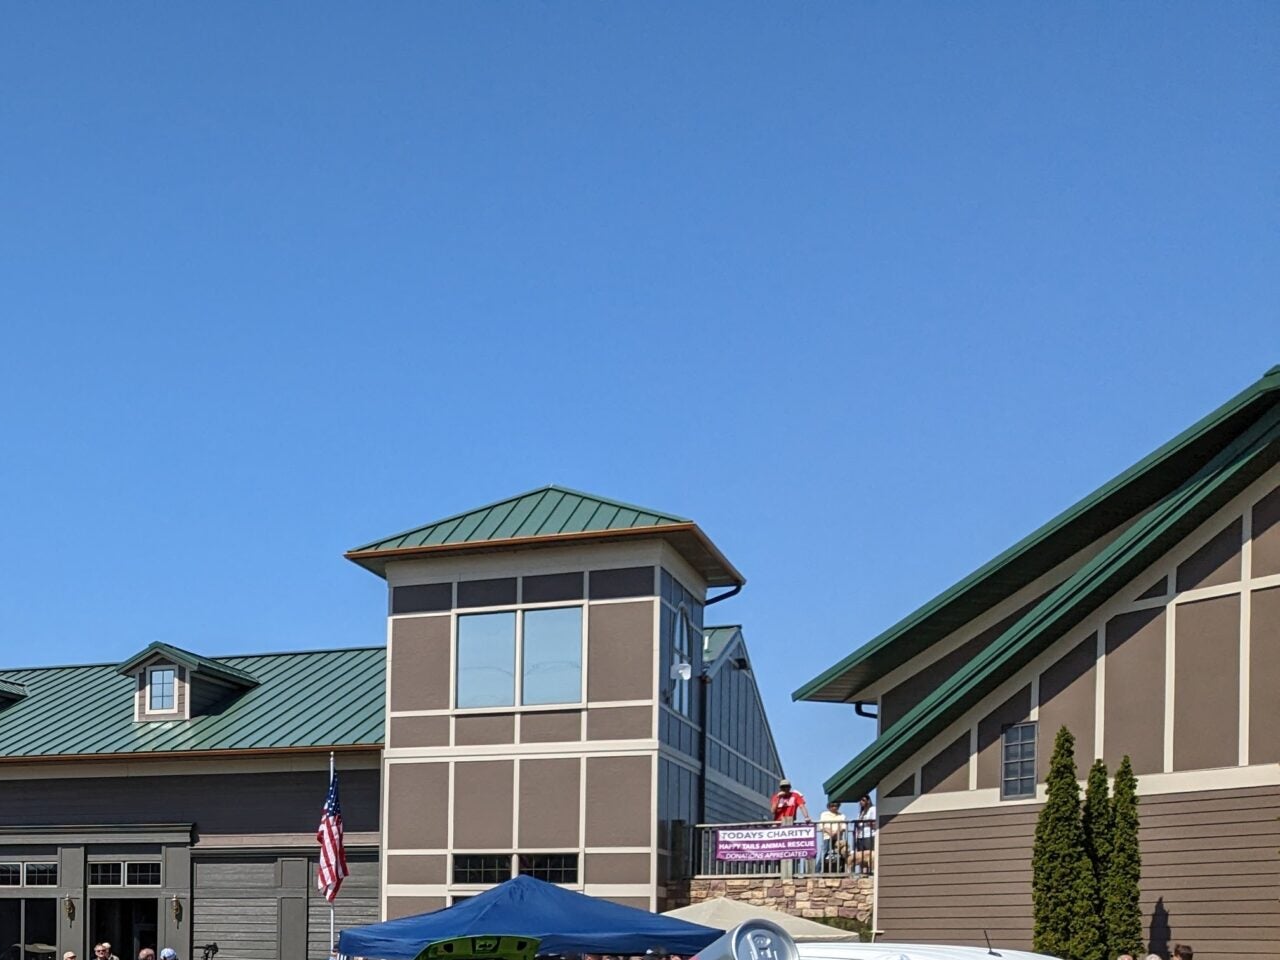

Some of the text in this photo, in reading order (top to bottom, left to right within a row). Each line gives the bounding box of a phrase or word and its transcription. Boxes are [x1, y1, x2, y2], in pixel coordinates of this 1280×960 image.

[721, 829, 811, 840] TODAYS CHARITY
[742, 842, 760, 850] TAILS
[760, 841, 786, 849] ANIMAL
[787, 840, 815, 848] RESCUE
